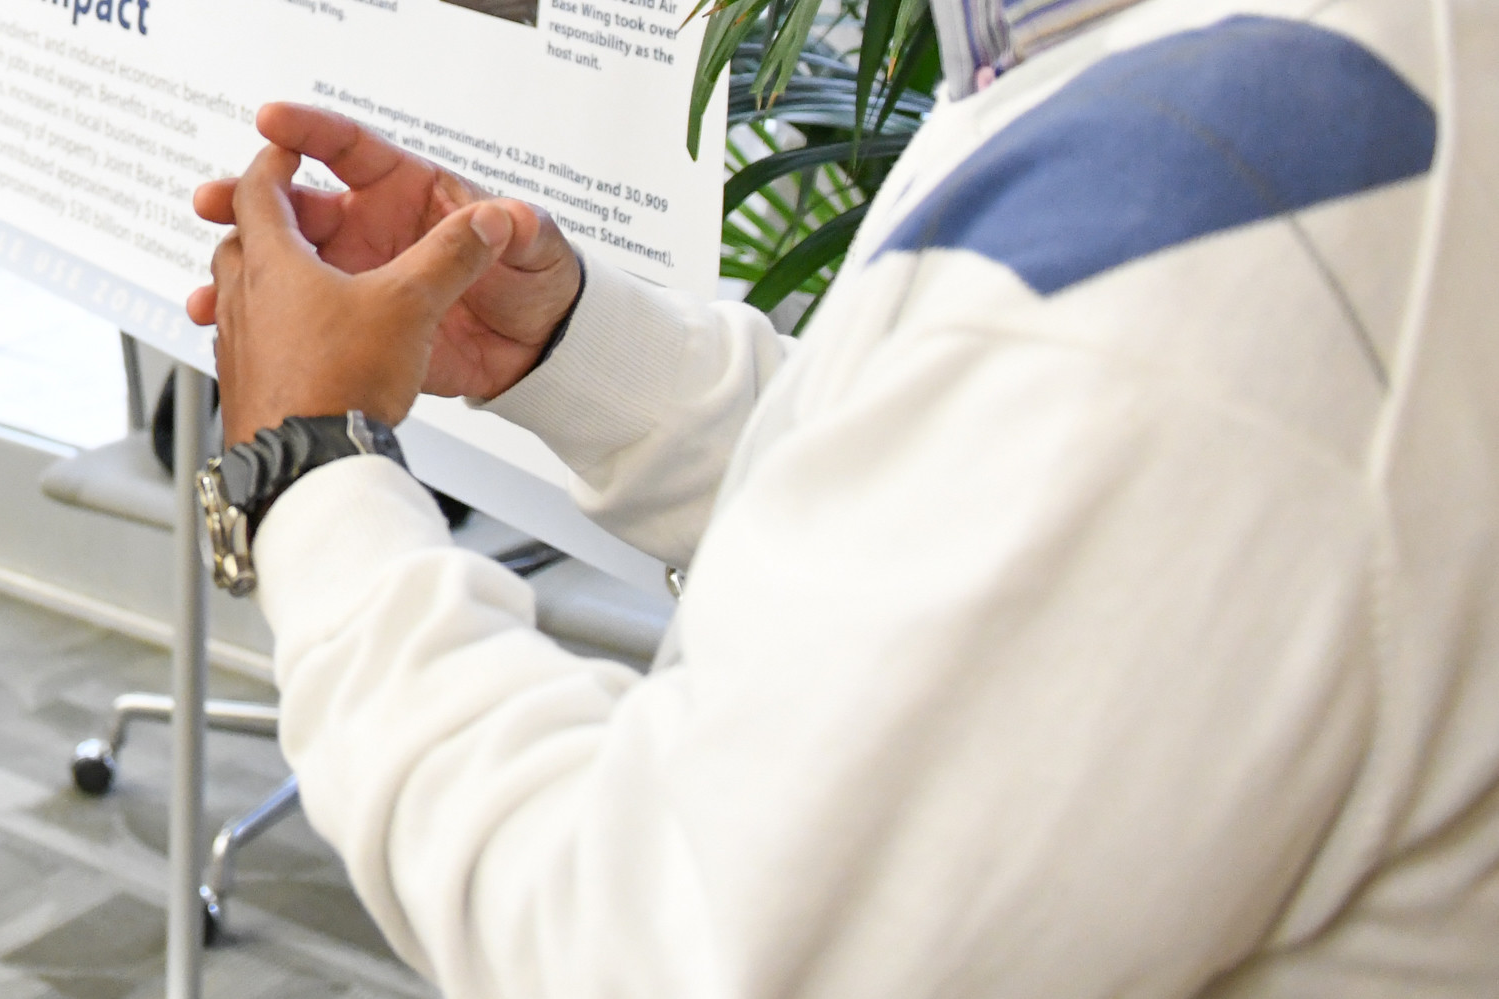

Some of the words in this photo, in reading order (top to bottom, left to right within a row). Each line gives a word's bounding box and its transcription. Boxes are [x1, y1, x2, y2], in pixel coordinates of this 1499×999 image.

[549, 22, 631, 57] responsibility
[635, 45, 649, 59] as
[653, 47, 673, 65] the
[581, 3, 611, 27] Wing
[614, 12, 645, 32] took
[649, 23, 678, 41] over
[546, 43, 571, 62] host
[575, 54, 602, 71] unit.
[338, 89, 375, 115] directly
[377, 105, 421, 129] employs
[423, 120, 502, 159] approximately
[548, 163, 593, 191] military
[596, 179, 621, 197] and
[625, 186, 667, 213] 30,909
[401, 136, 425, 153] with
[427, 146, 468, 172] military
[471, 157, 540, 194] dependents
[543, 185, 609, 221] accounting
[612, 204, 631, 225] for
[553, 211, 596, 240] Impact
[599, 227, 675, 270] Statement).
